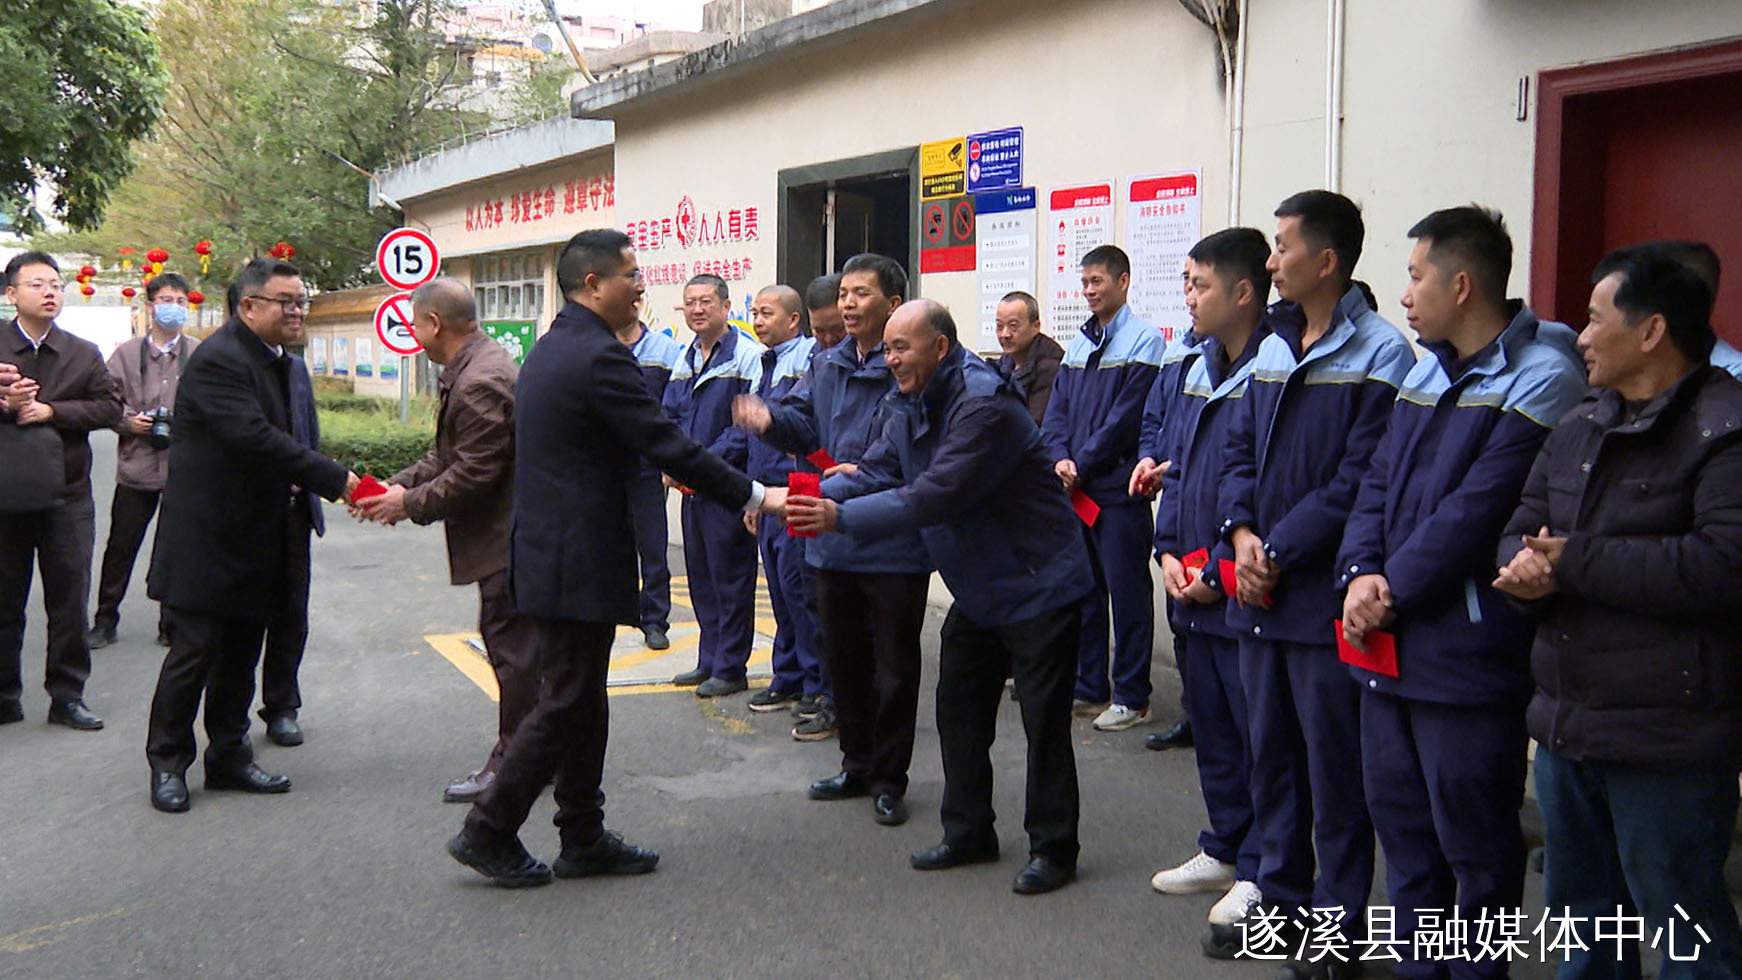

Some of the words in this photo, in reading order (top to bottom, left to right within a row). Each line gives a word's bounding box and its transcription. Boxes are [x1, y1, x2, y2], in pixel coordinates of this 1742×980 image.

[465, 196, 504, 231] 以人为本
[510, 184, 555, 224] 珍爱生命
[563, 172, 614, 214] 遵章守法
[626, 218, 671, 248] 安全生产
[698, 207, 758, 242] 人人有责
[393, 245, 423, 274] 15
